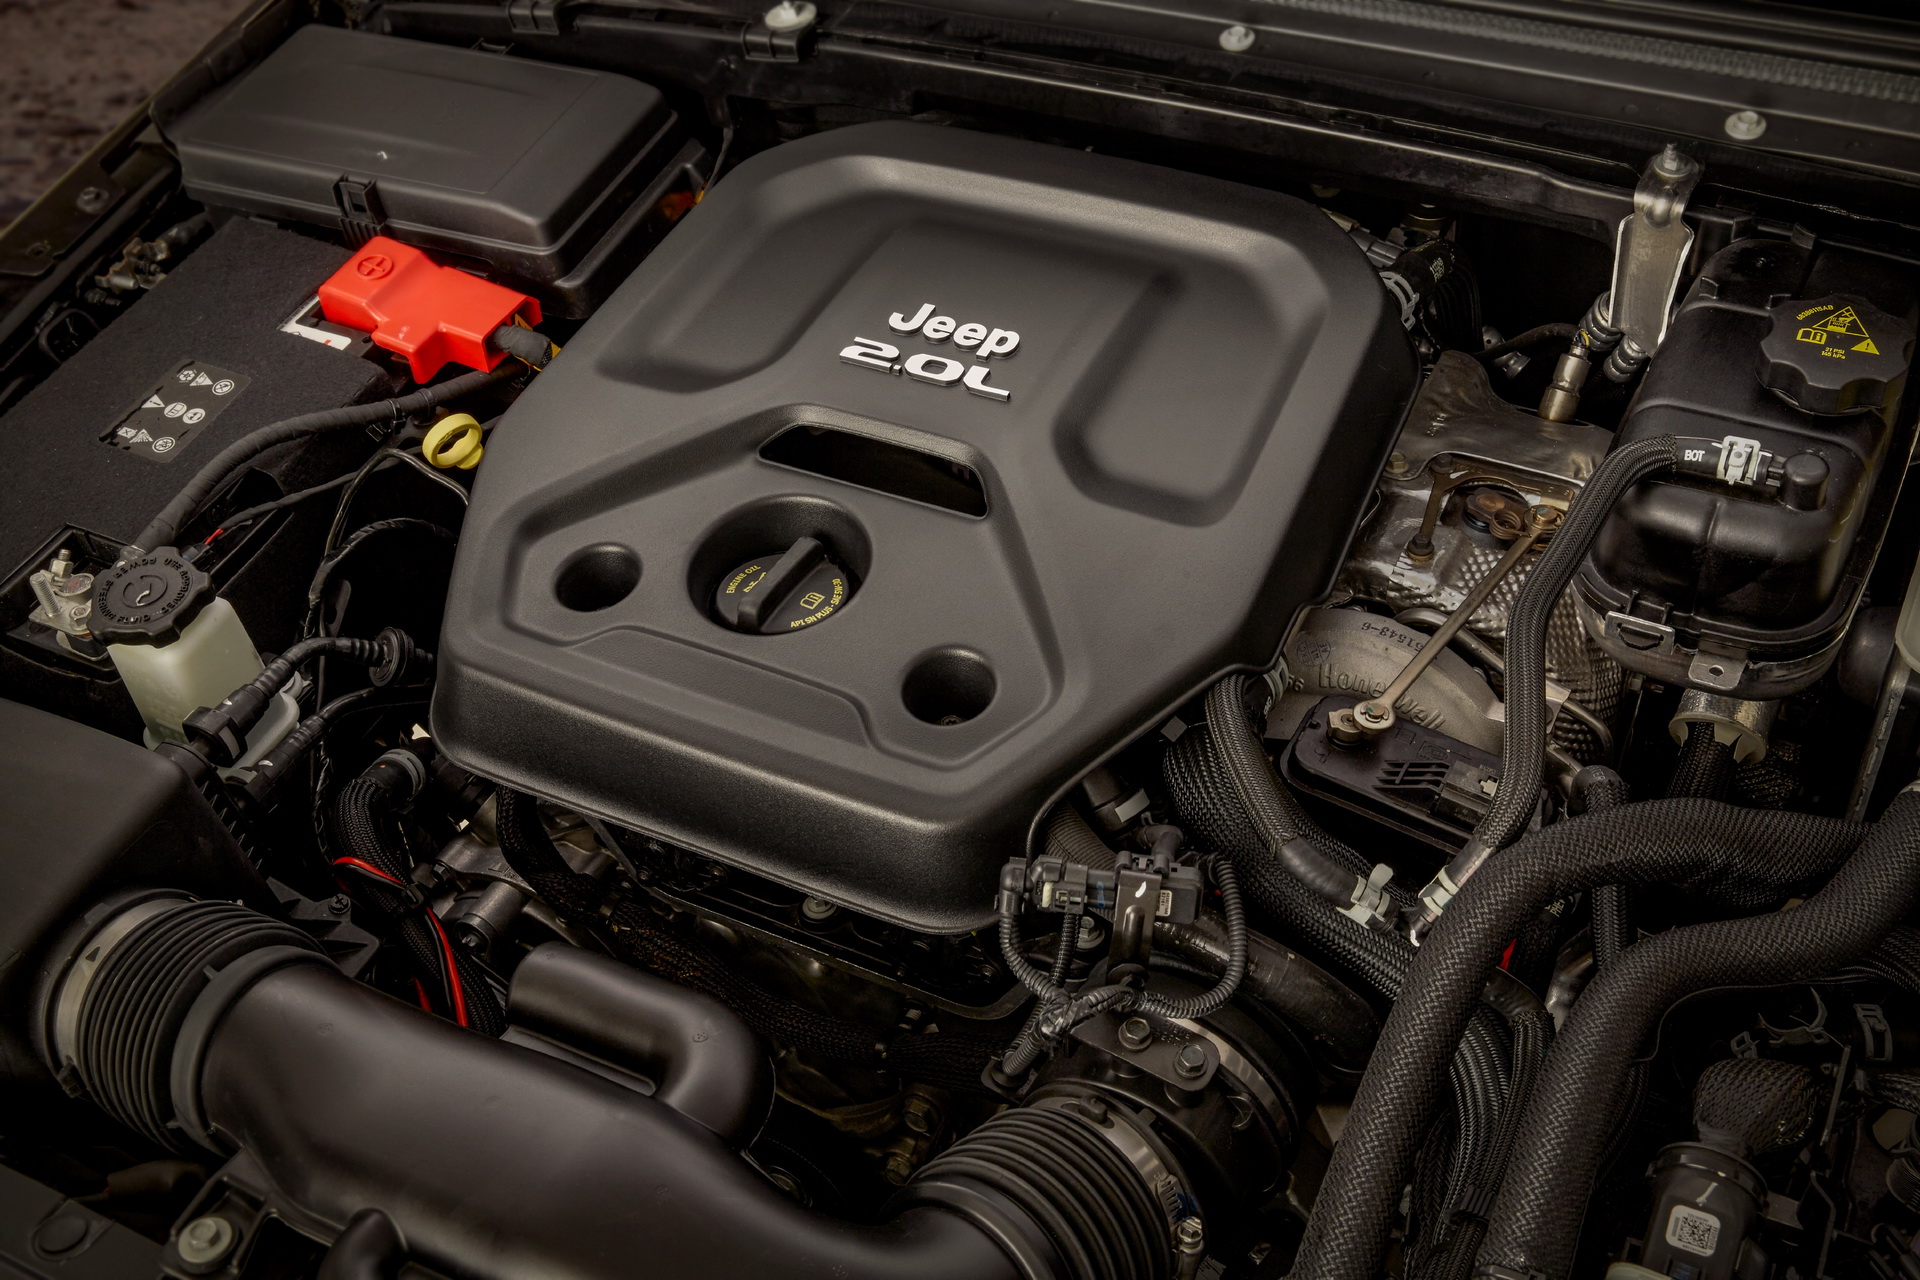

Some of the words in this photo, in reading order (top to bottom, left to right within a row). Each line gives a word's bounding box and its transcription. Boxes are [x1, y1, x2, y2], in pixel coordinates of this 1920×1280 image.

[888, 303, 1020, 361] Jeep
[839, 337, 1011, 402] 2.0L
[1684, 450, 1705, 462] BOT
[114, 557, 156, 578] POWER
[726, 573, 747, 594] ENGINE
[745, 565, 761, 574] OIL
[832, 578, 845, 594] 5W-30
[831, 594, 843, 605] SAE
[805, 615, 817, 625] SN
[815, 606, 832, 619] PLUS
[790, 619, 806, 628] API
[1318, 664, 1446, 730] Honewell
